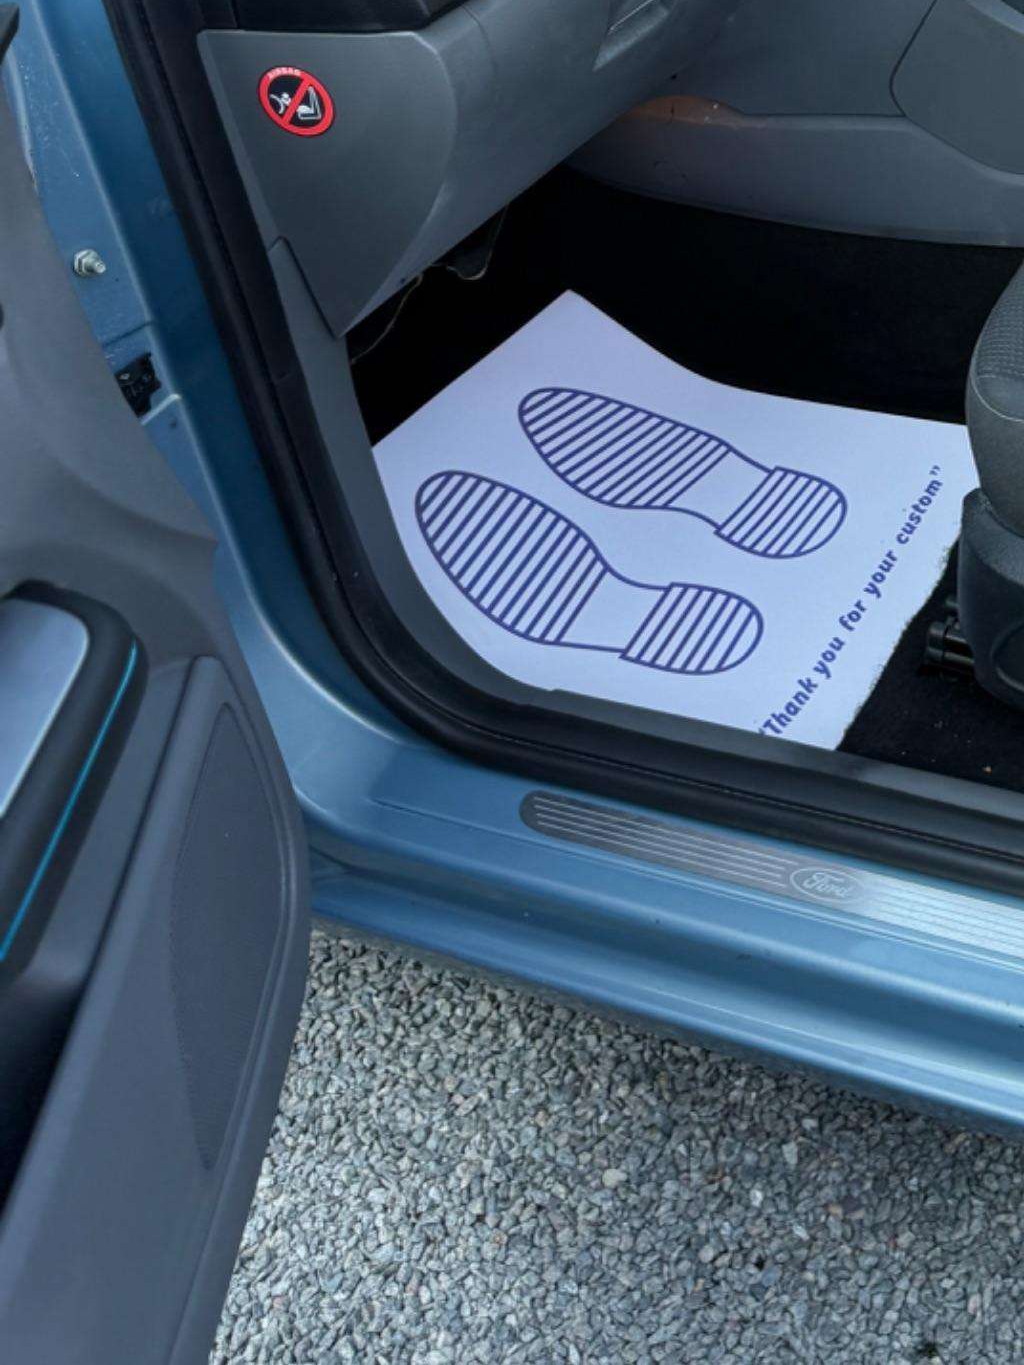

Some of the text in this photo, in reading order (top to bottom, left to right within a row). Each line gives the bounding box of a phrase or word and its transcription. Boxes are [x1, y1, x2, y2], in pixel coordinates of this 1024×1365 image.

[814, 637, 845, 679] you
[839, 600, 866, 632] for
[864, 550, 898, 598] your
[803, 872, 853, 898] Ford
